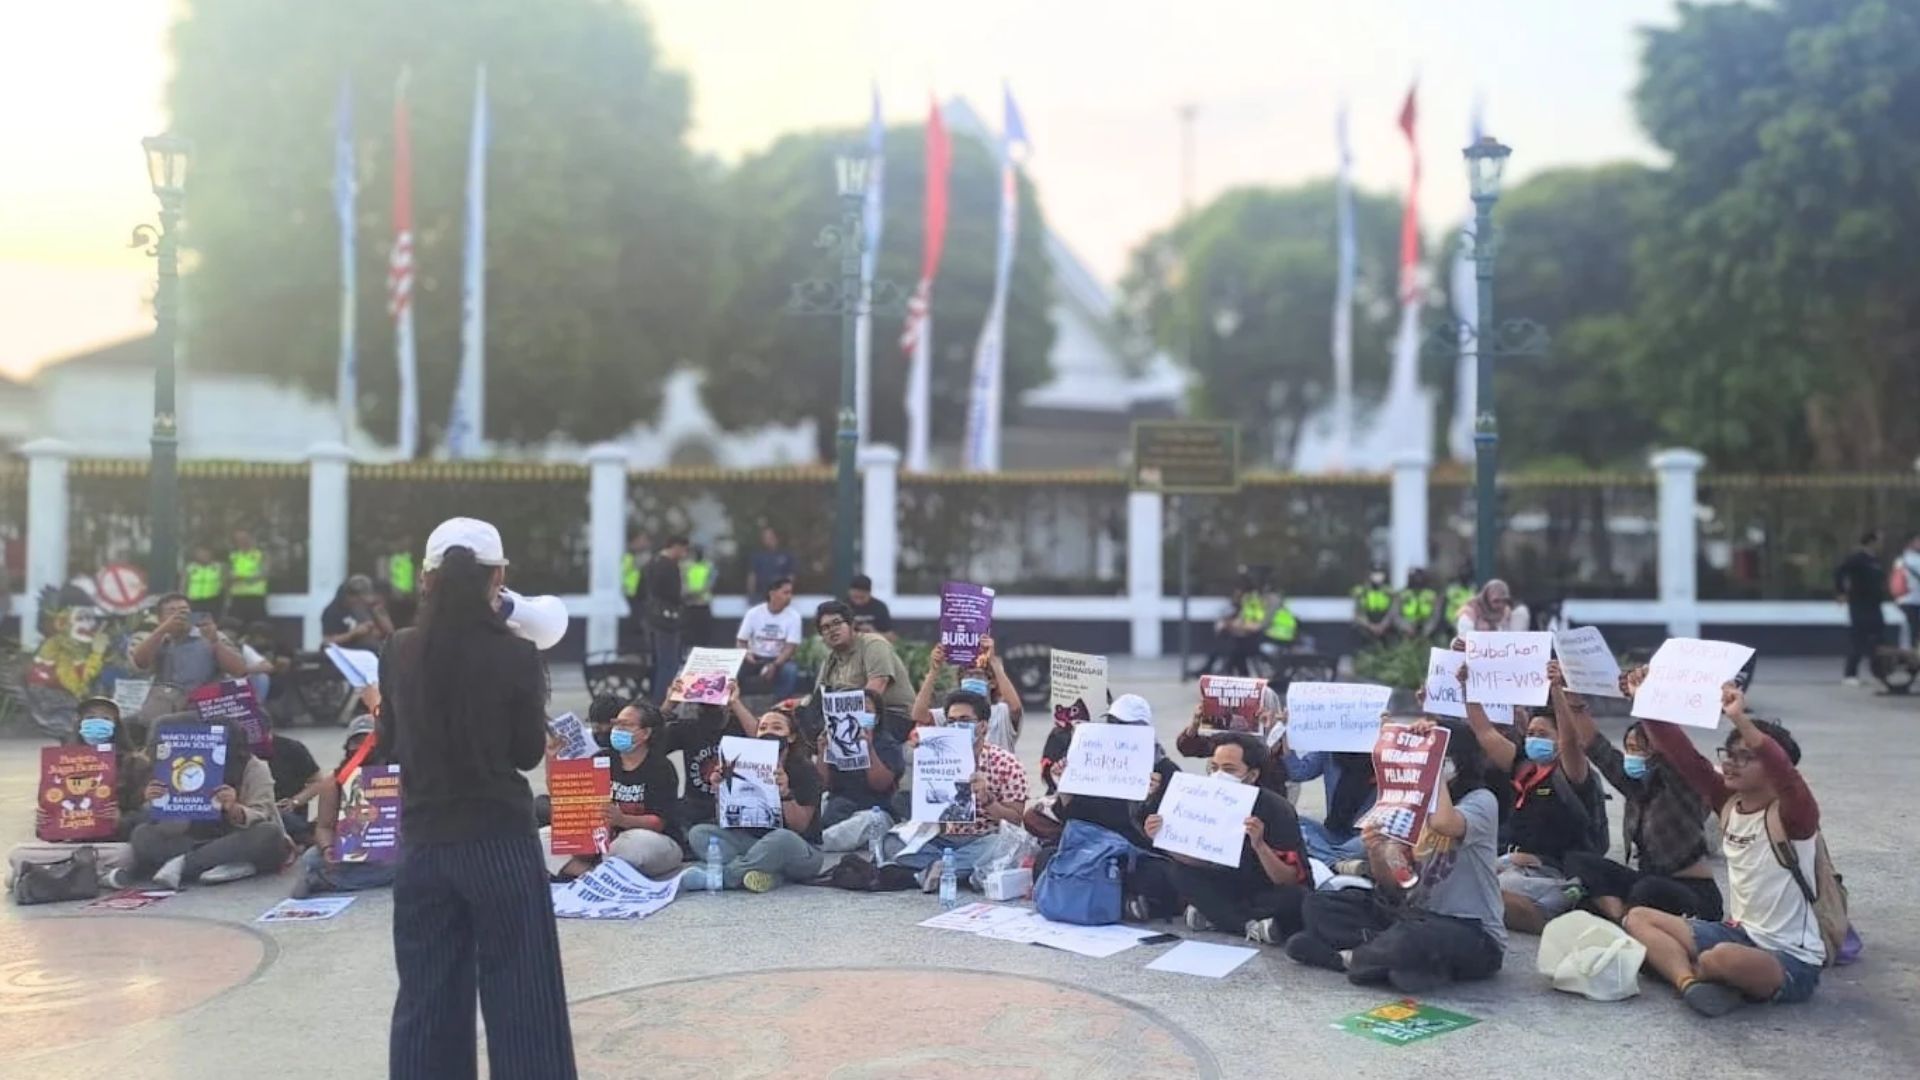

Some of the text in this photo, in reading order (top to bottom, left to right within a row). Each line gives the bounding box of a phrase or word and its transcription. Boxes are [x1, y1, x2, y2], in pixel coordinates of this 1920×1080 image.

[1471, 671, 1544, 688] IMF-WB
[1428, 687, 1461, 702] WORL
[1397, 732, 1425, 748] STOP
